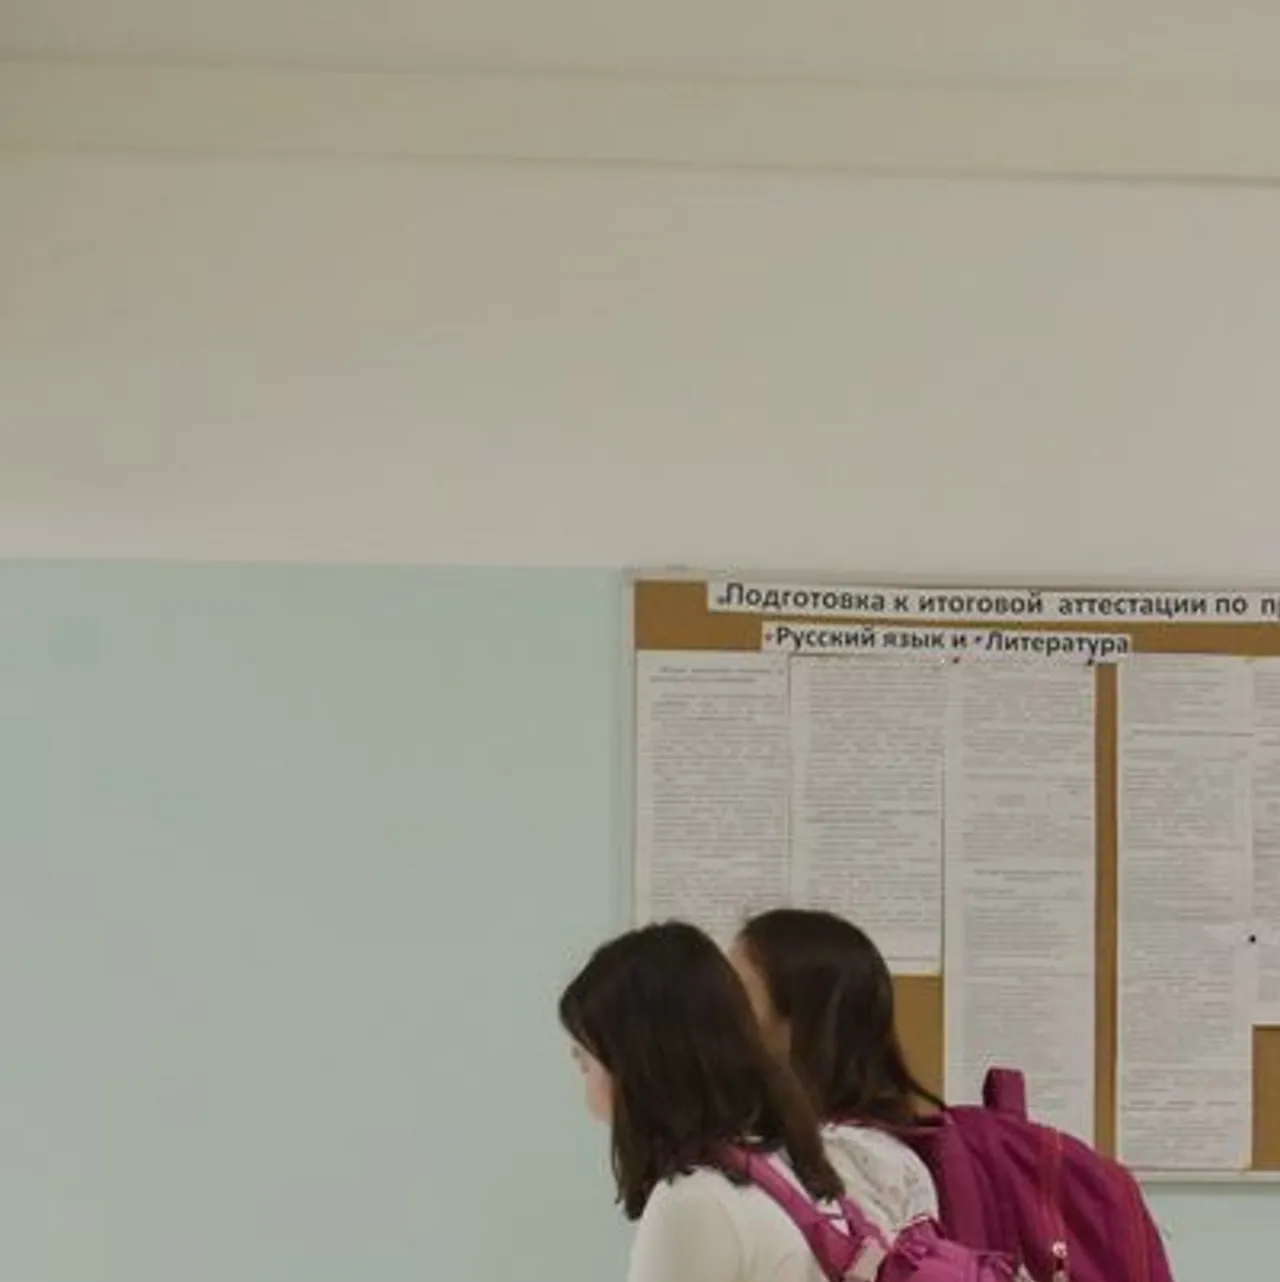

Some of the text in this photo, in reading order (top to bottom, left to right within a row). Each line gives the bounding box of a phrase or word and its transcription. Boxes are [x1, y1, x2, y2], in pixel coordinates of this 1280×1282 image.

[726, 582, 885, 610] Подготовка
[894, 598, 909, 611] к
[919, 591, 1042, 613] итоговой
[1058, 596, 1207, 618] аттестации
[1216, 596, 1249, 614] по
[776, 626, 1128, 656] Русский язык и Литература
